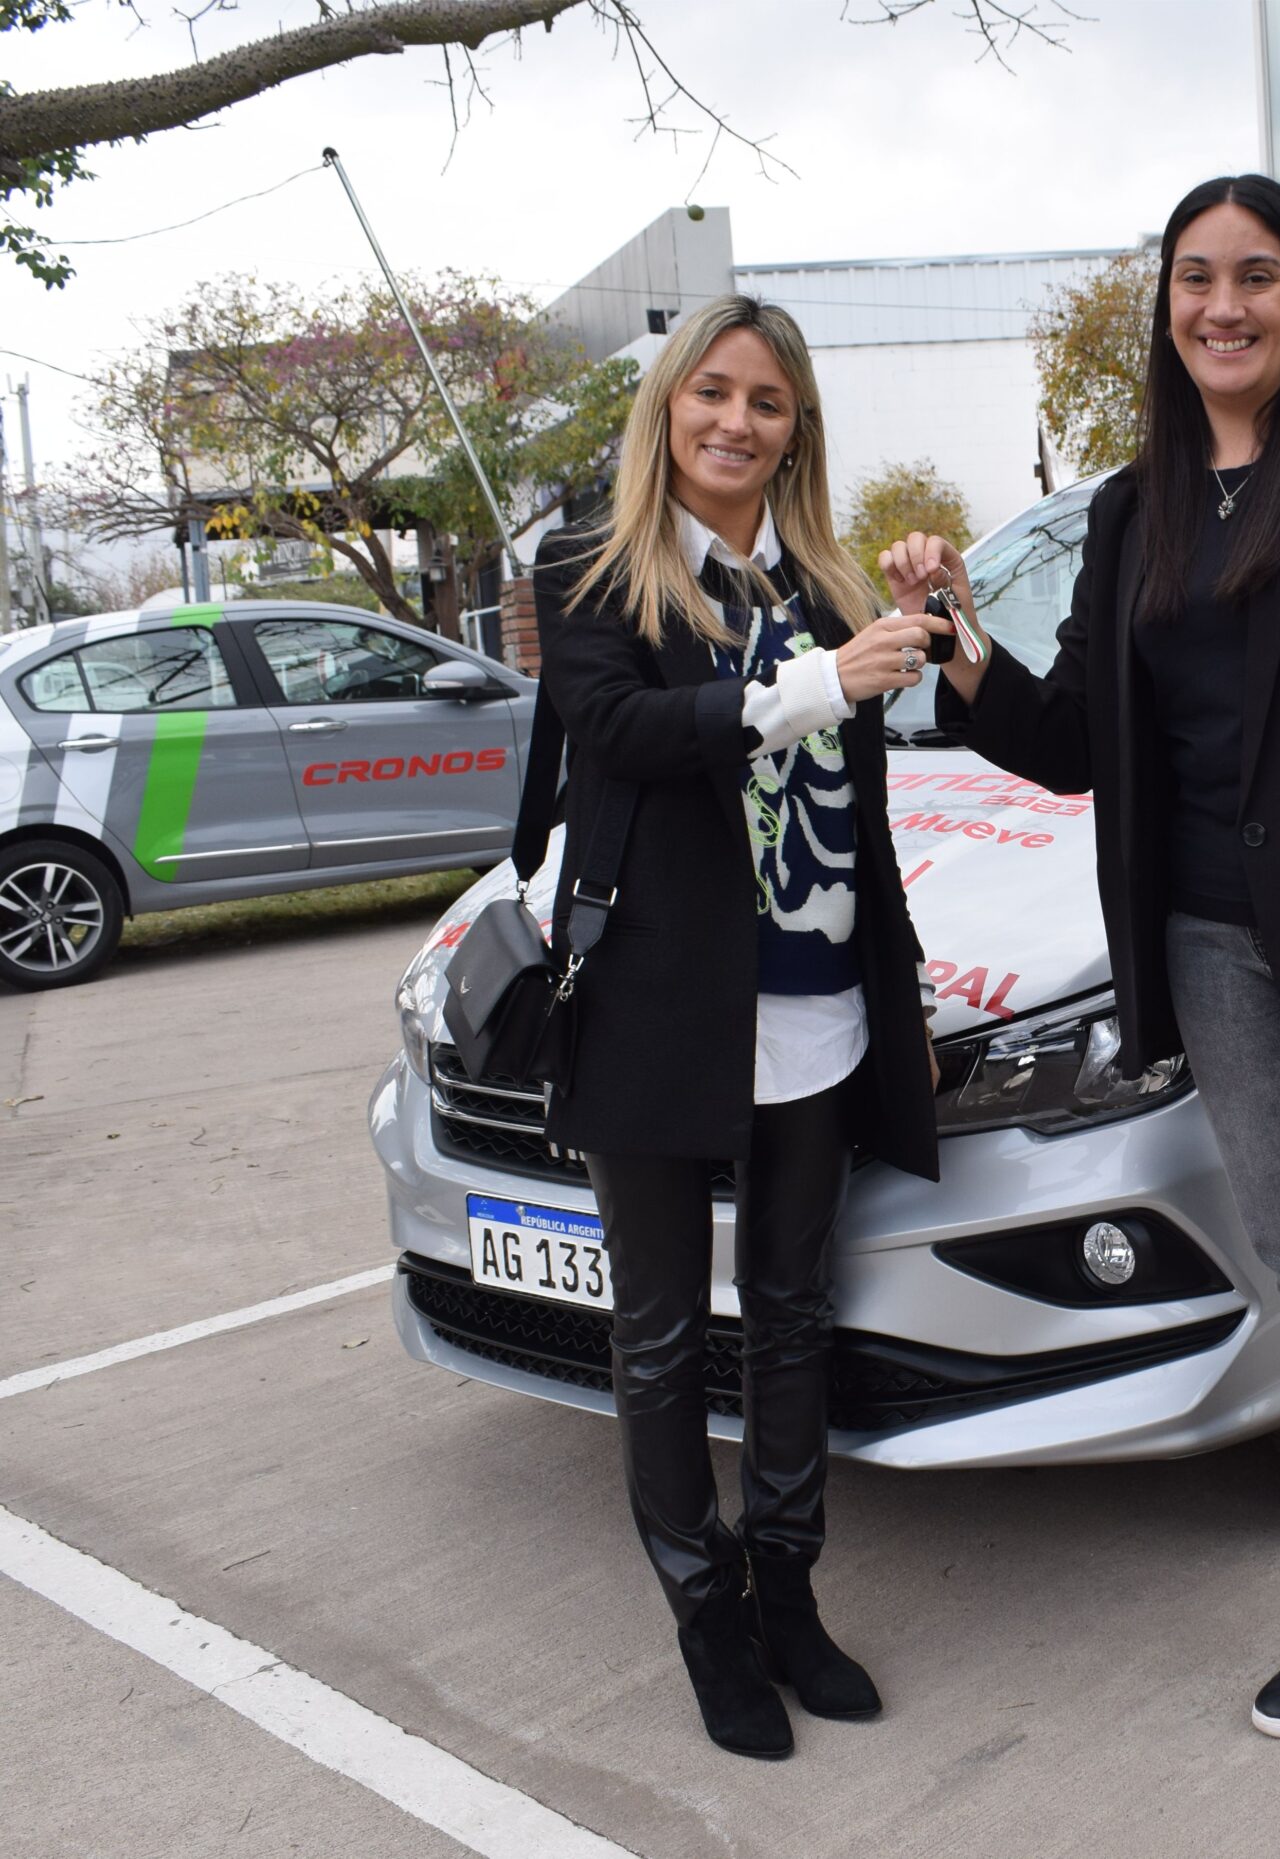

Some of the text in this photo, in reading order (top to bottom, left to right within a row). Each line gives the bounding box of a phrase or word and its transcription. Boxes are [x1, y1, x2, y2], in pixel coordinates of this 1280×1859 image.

[302, 747, 507, 787] CRONOS
[979, 794, 1090, 817] 2023
[890, 812, 1054, 848] Mueve
[520, 1214, 566, 1232] REPÚBLICA
[483, 1227, 603, 1298] AG 133
